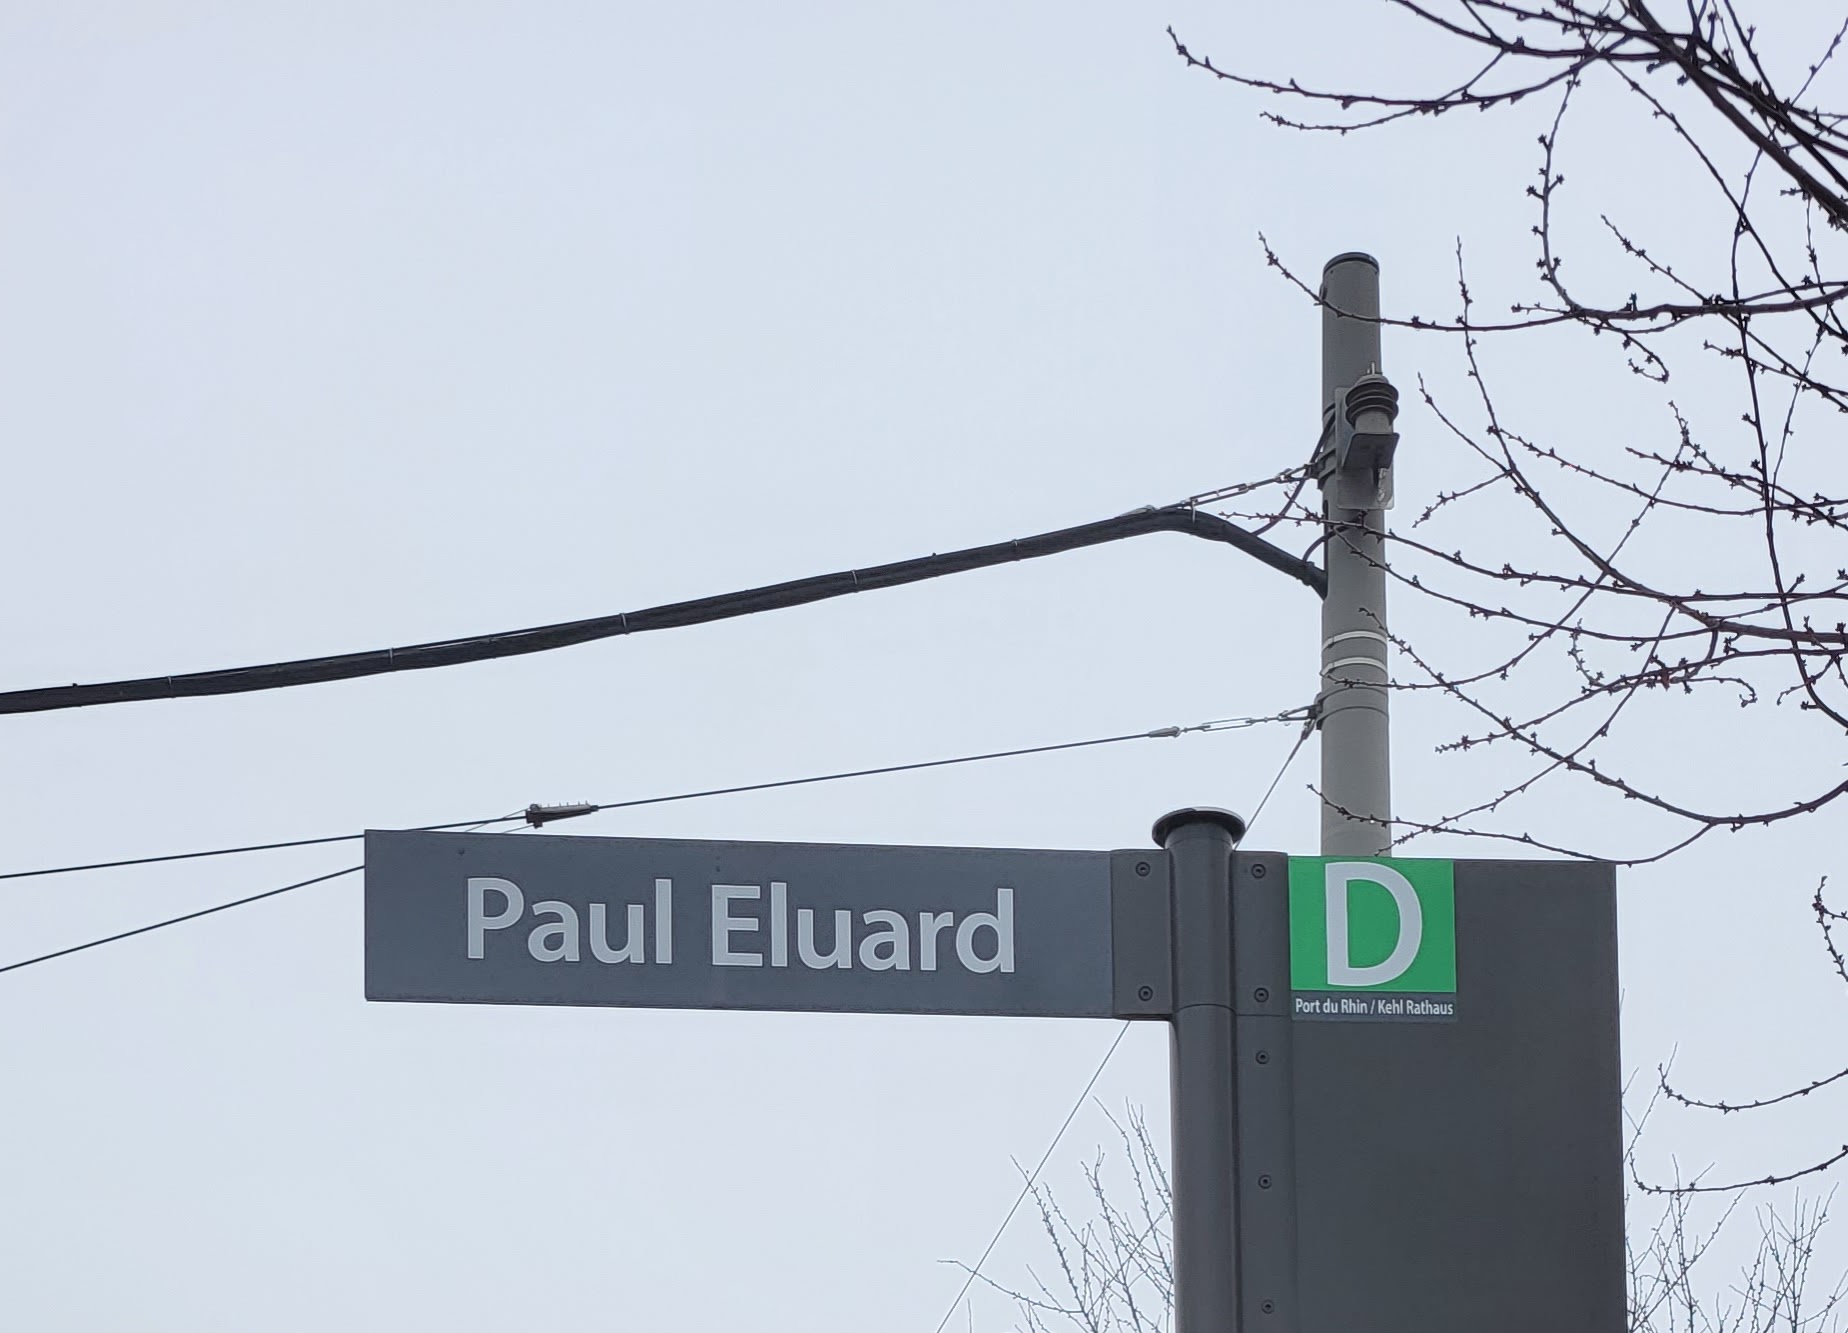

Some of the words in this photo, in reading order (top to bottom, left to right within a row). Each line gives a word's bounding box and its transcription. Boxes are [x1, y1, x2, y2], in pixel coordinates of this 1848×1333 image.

[465, 876, 673, 965] Paul
[710, 881, 1015, 974] Eluard
[1324, 861, 1423, 987] D
[1295, 998, 1321, 1014] Port
[1322, 998, 1338, 1014] du
[1341, 999, 1368, 1014] Rhin
[1378, 999, 1403, 1015] Kehl
[1406, 1000, 1454, 1015] Rathaus
